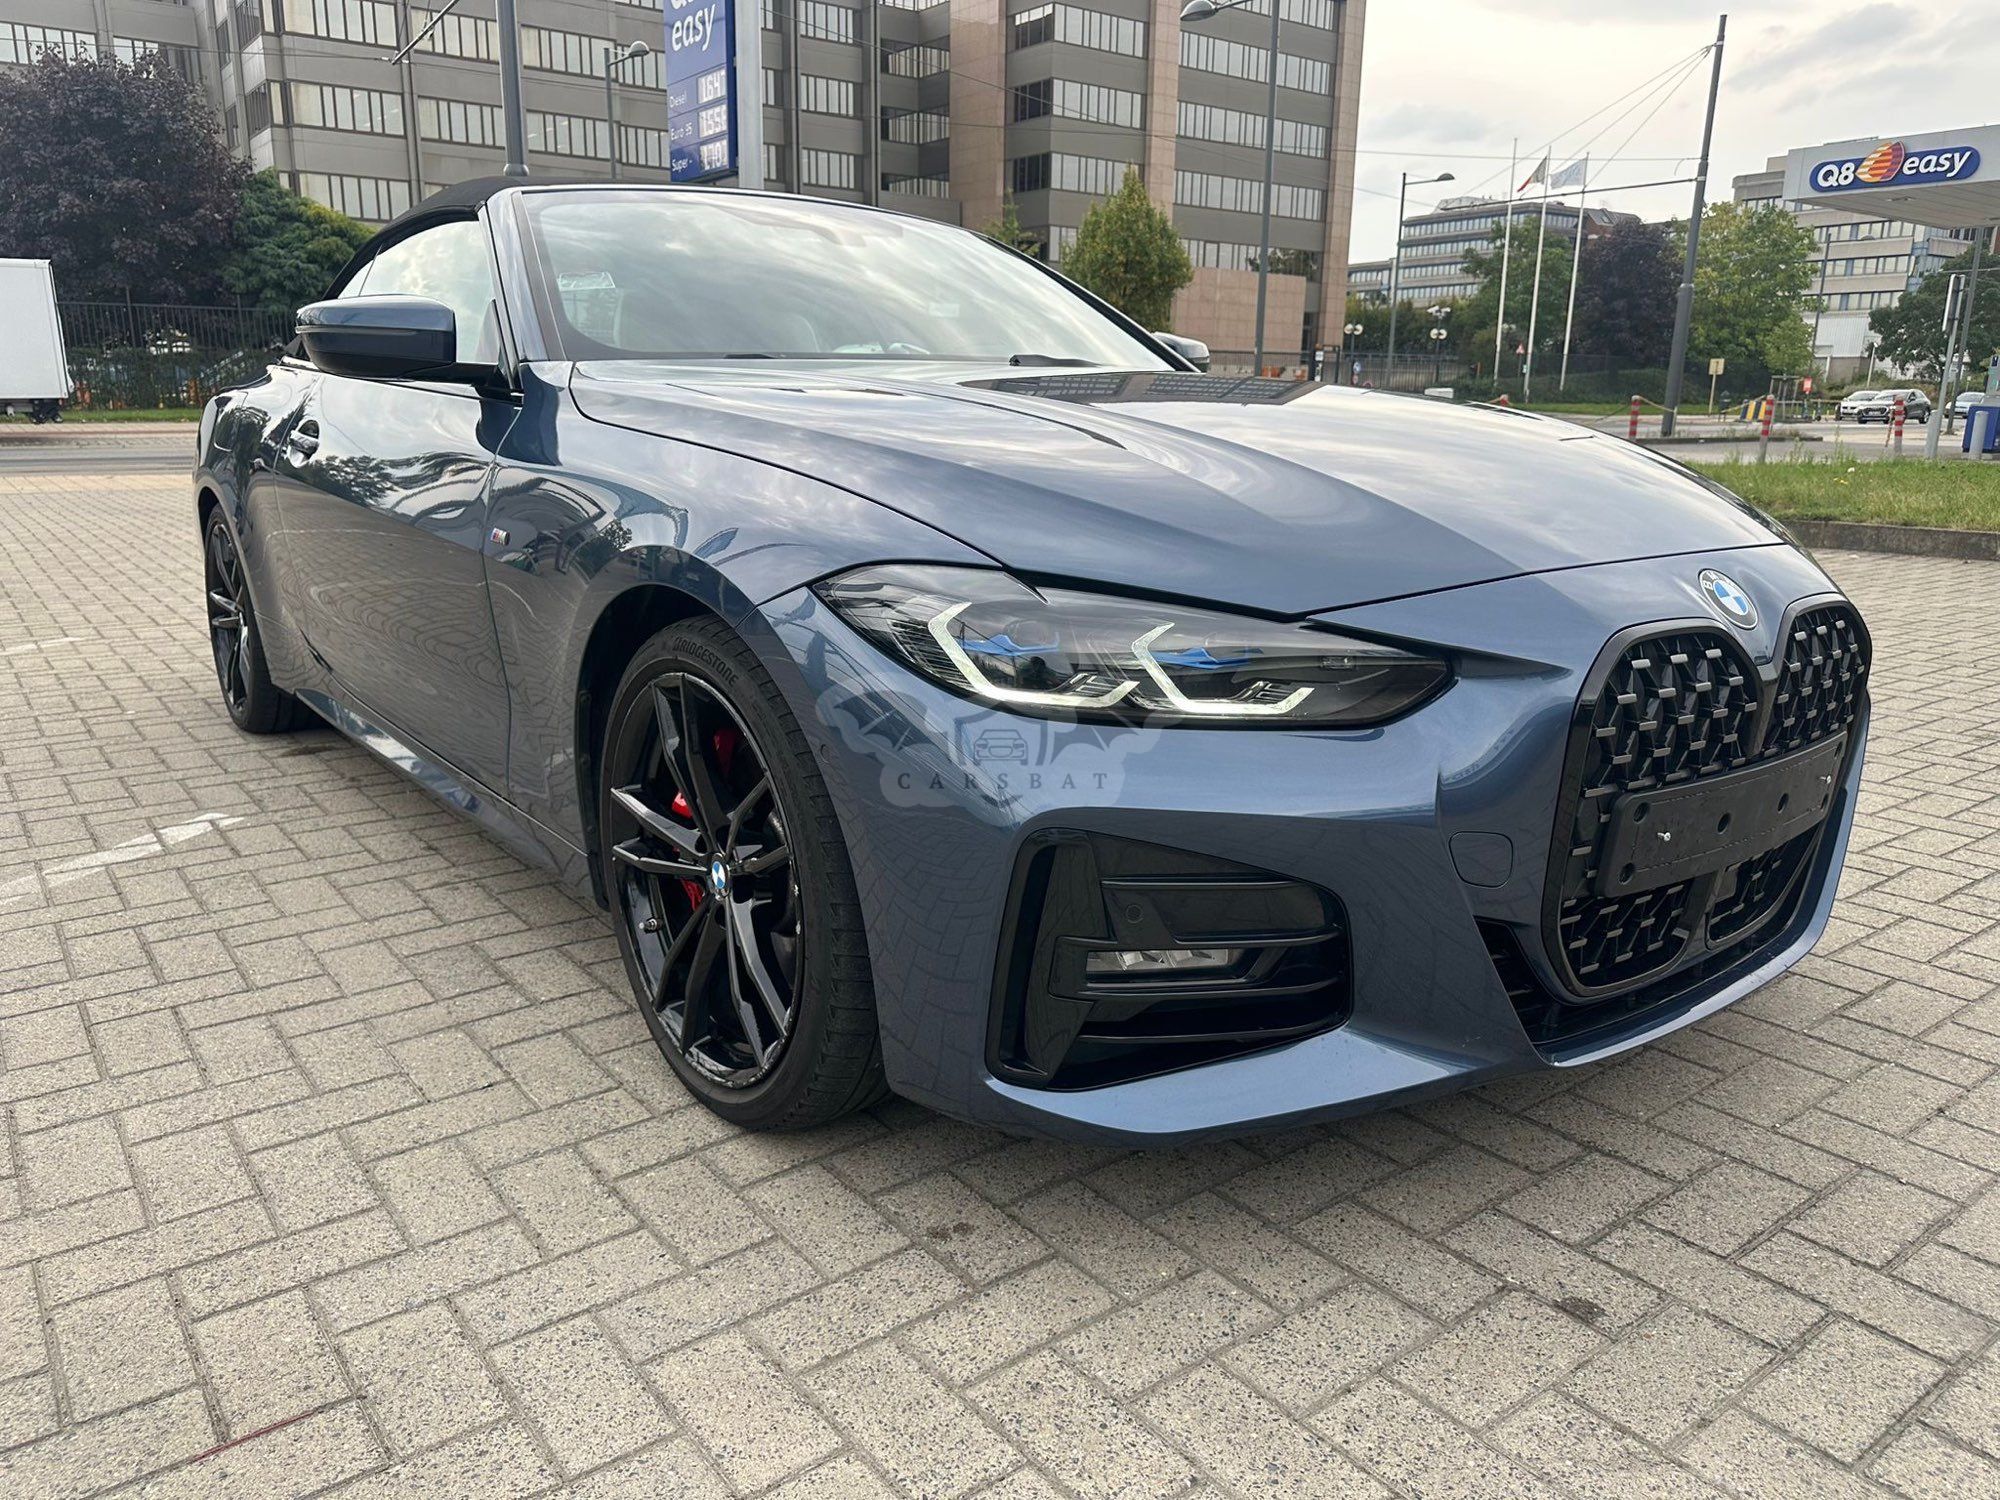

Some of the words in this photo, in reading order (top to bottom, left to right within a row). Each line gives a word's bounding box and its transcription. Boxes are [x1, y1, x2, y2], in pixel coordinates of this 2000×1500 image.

[672, 4, 716, 51] easy
[1817, 162, 1855, 187] Q8
[1902, 150, 1971, 177] easy
